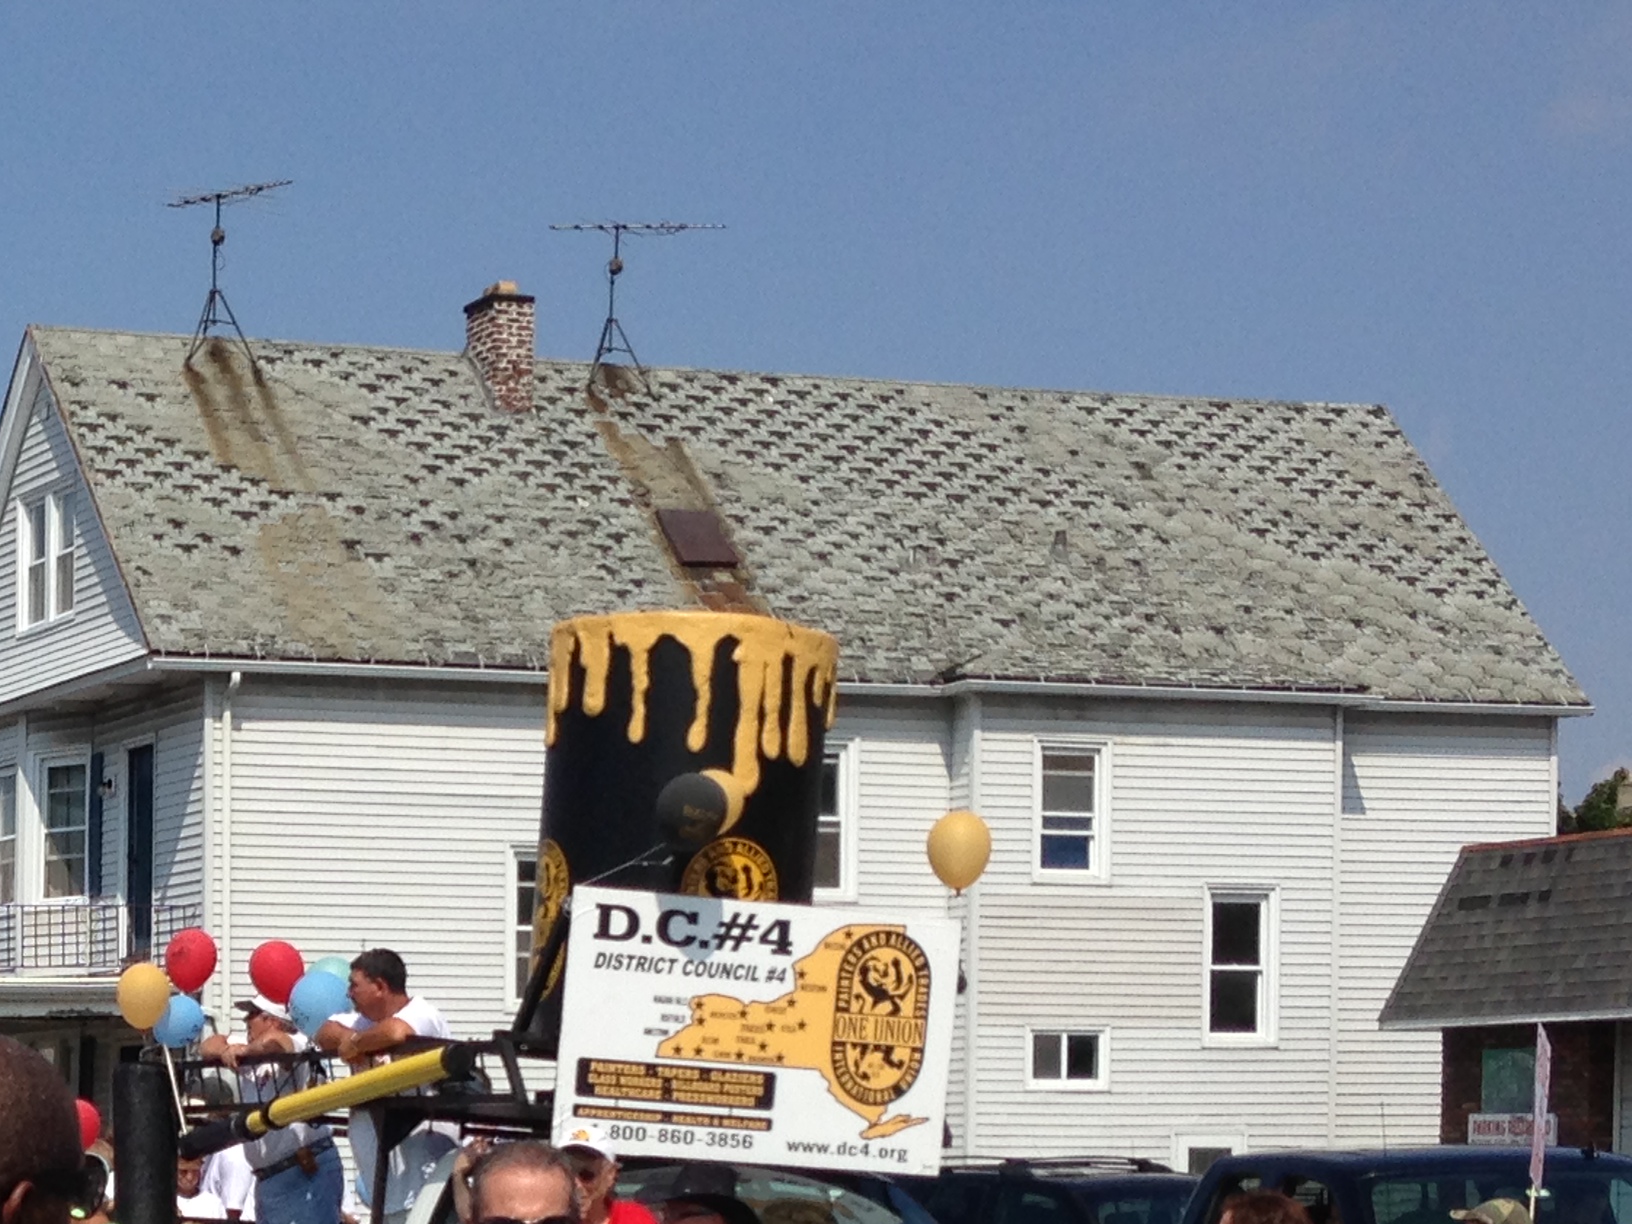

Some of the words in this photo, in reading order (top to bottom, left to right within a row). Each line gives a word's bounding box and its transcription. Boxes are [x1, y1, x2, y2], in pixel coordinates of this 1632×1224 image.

[593, 903, 793, 956] D.C.#4
[864, 933, 887, 951] AND
[594, 951, 678, 975] DISTRICT
[682, 958, 759, 983] COUNCIL
[765, 966, 788, 983] #4
[835, 1015, 869, 1040] ONE
[874, 1018, 925, 1045] UNION
[592, 1122, 754, 1150] 800-860-3856
[786, 1138, 909, 1163] www.dc4.org
